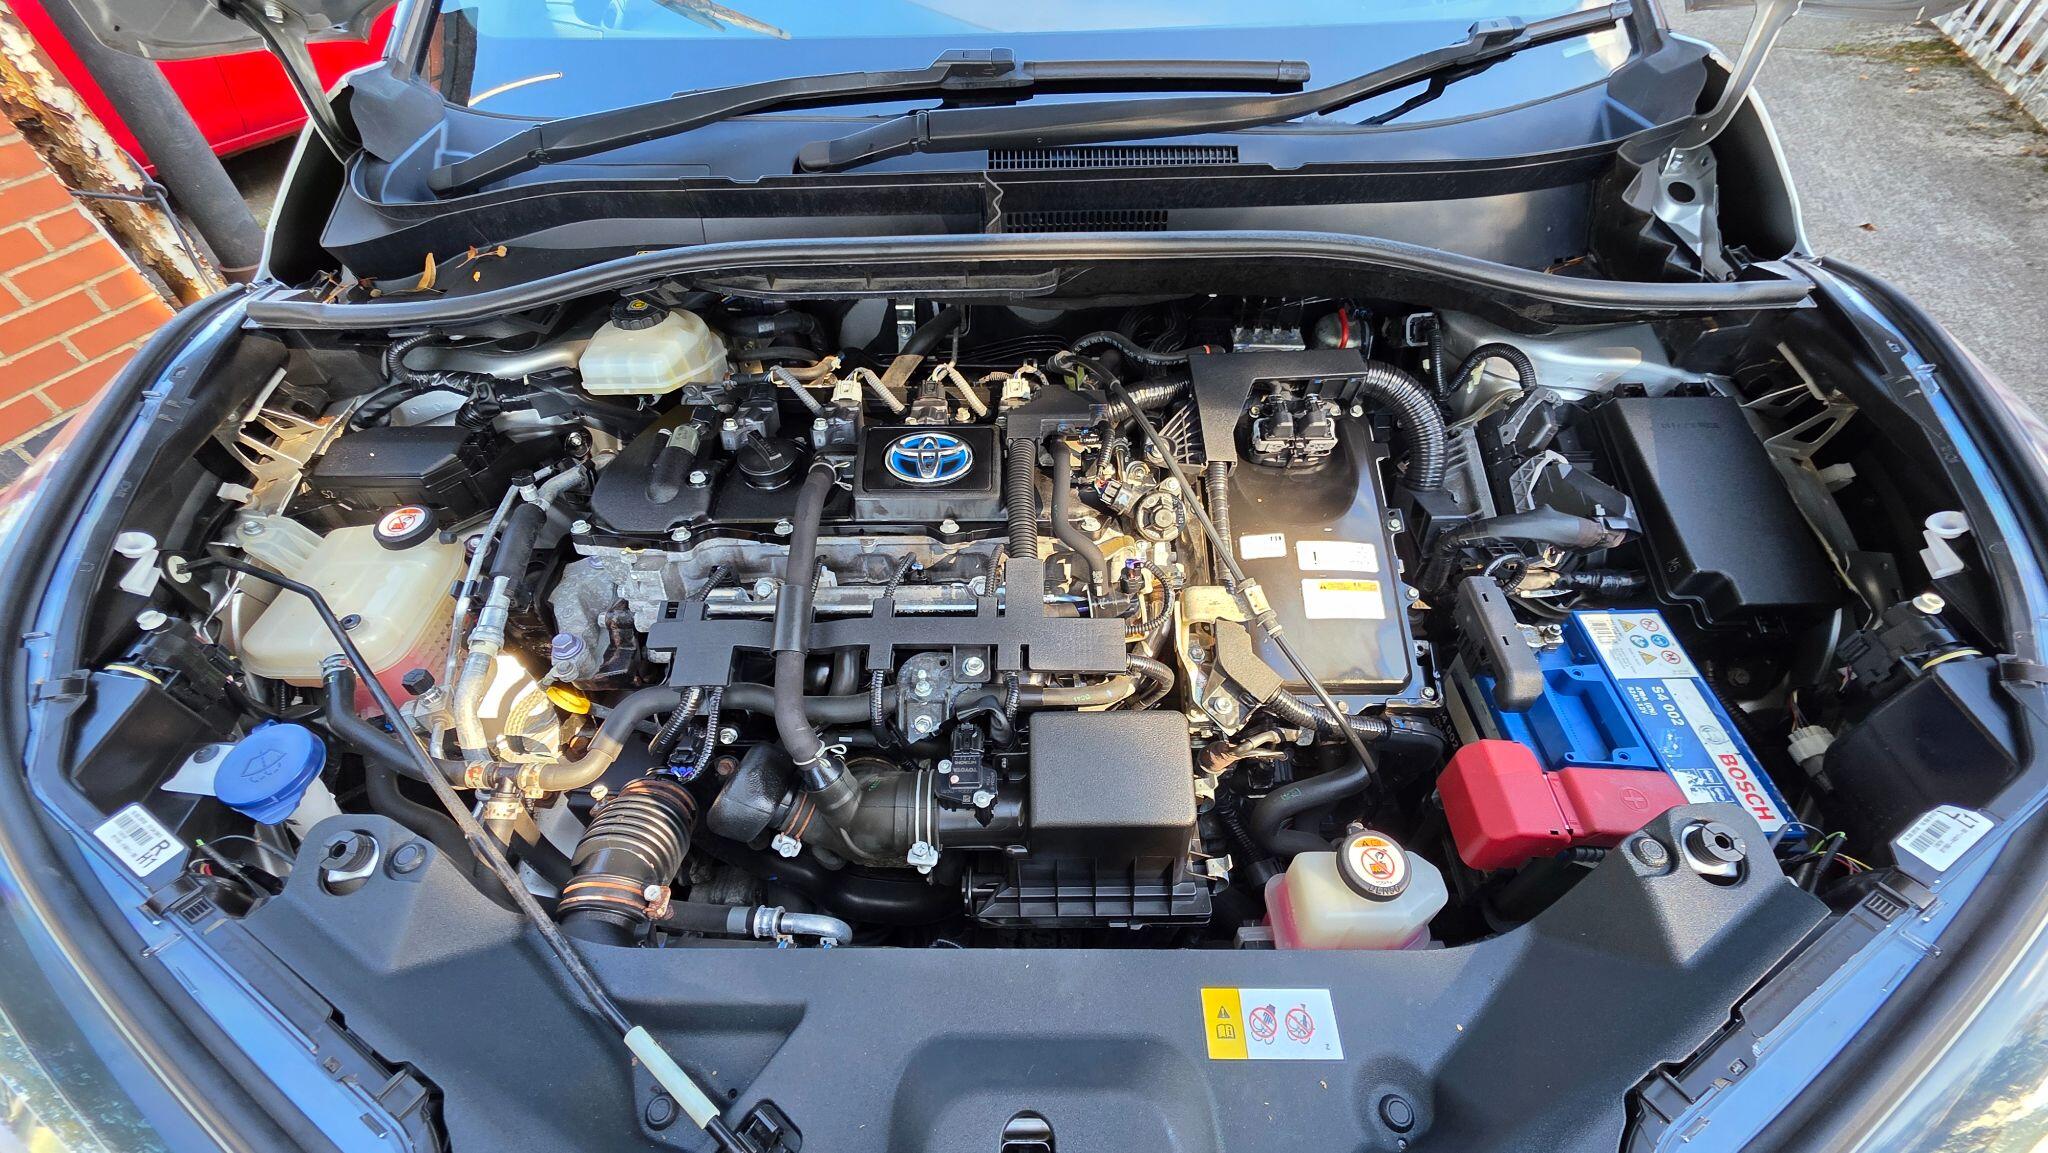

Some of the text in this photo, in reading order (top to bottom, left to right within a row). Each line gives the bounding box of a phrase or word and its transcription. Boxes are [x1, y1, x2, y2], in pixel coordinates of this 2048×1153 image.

[1651, 686, 1685, 727] S4 002
[1717, 753, 1776, 821] BOSCH
[150, 839, 171, 856] R
